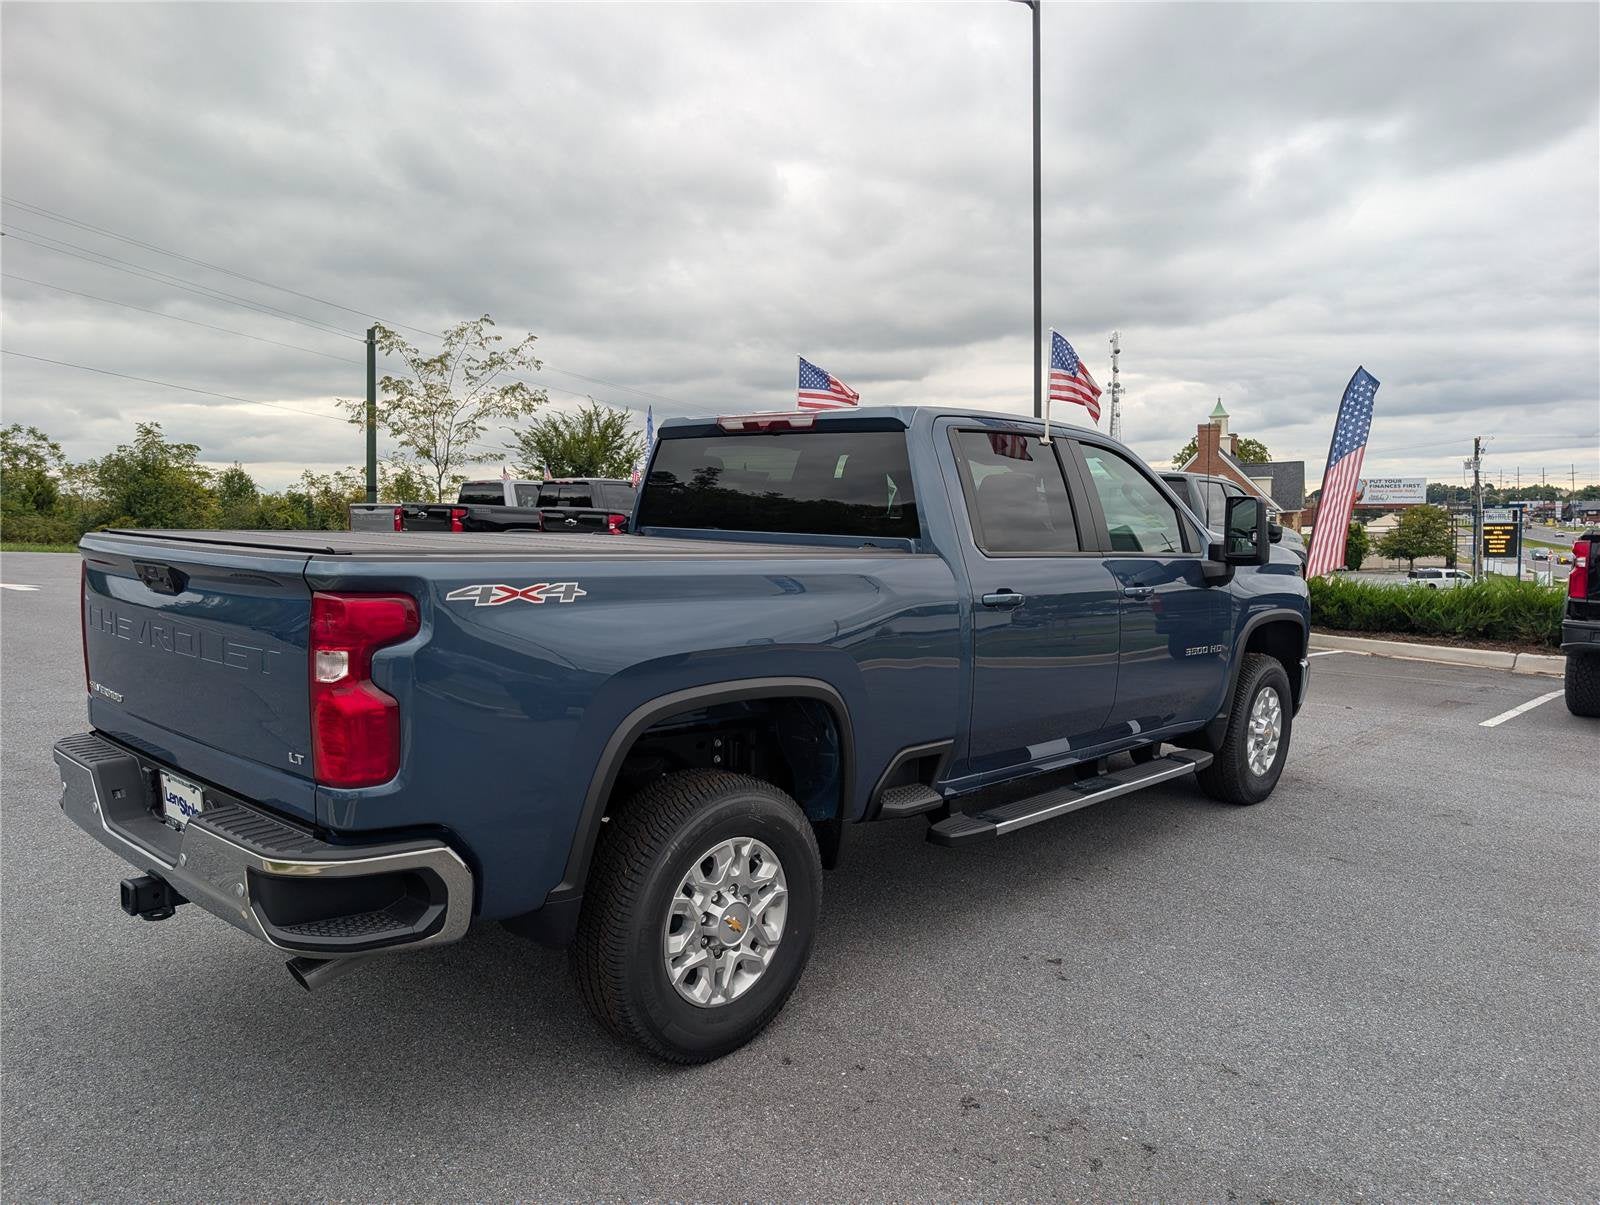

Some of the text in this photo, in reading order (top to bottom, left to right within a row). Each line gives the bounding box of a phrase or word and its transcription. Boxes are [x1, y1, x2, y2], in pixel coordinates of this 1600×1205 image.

[89, 604, 280, 675] CHEVROLET
[1210, 644, 1222, 653] HD
[288, 752, 304, 765] LT
